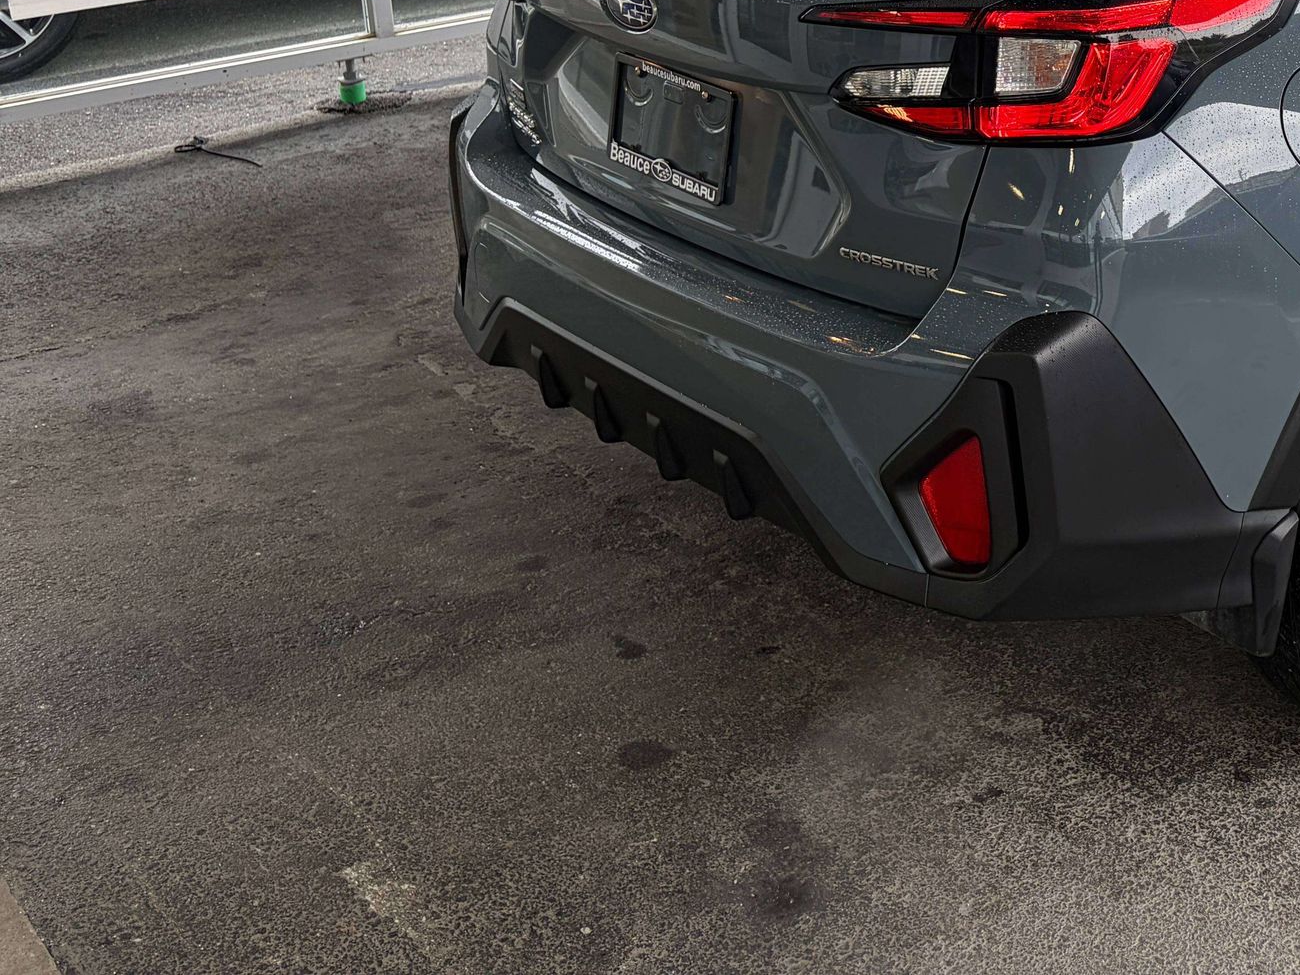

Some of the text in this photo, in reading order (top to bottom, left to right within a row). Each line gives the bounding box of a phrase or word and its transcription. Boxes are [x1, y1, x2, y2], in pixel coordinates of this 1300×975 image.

[641, 61, 701, 92] beaucesubaru.com
[610, 142, 716, 202] Beauce SUBARU
[839, 246, 939, 281] CROSSTREK
